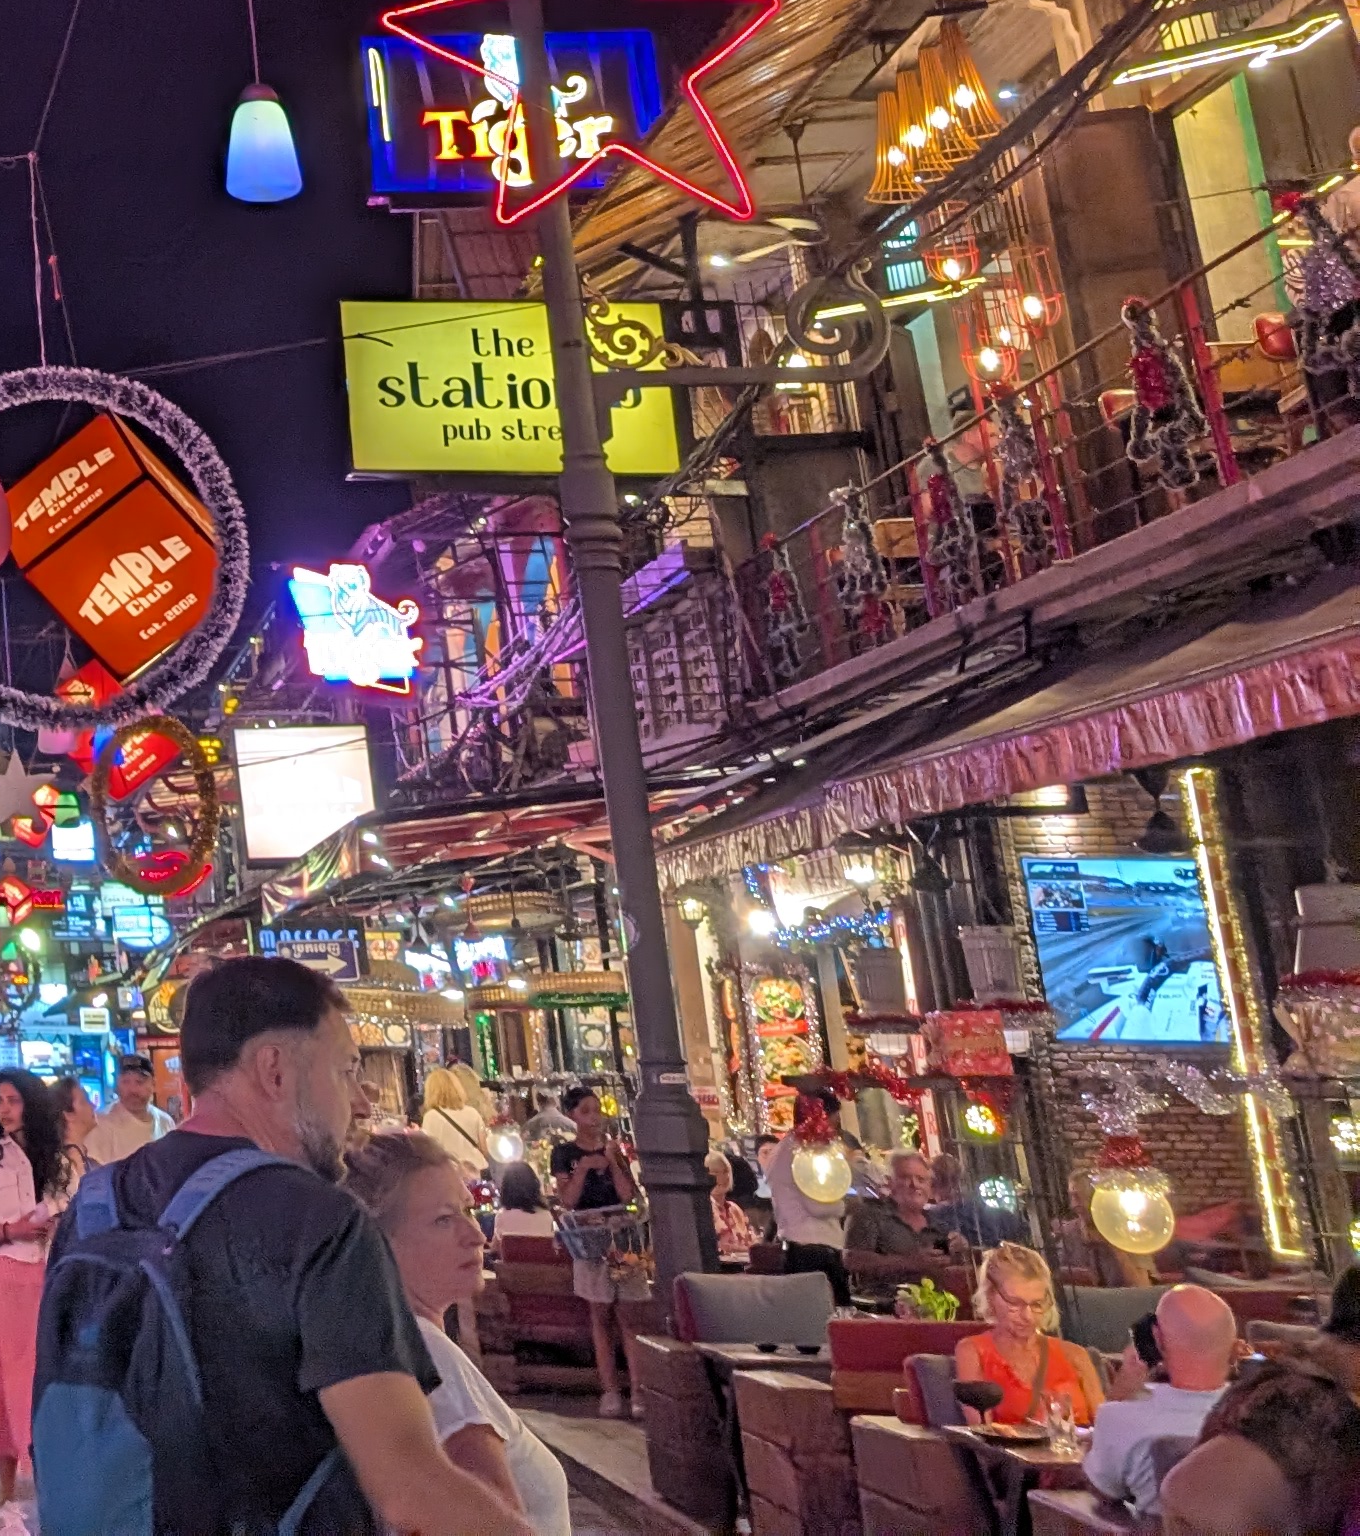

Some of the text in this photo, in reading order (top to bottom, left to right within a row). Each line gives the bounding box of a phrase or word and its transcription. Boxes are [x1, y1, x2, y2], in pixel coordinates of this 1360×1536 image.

[471, 328, 534, 358] the
[377, 361, 560, 410] statio
[442, 418, 563, 447] pub stre
[14, 447, 116, 532] TEMPLE
[47, 482, 89, 517] Club
[78, 535, 193, 626] TEMPLE
[124, 580, 173, 618] Club
